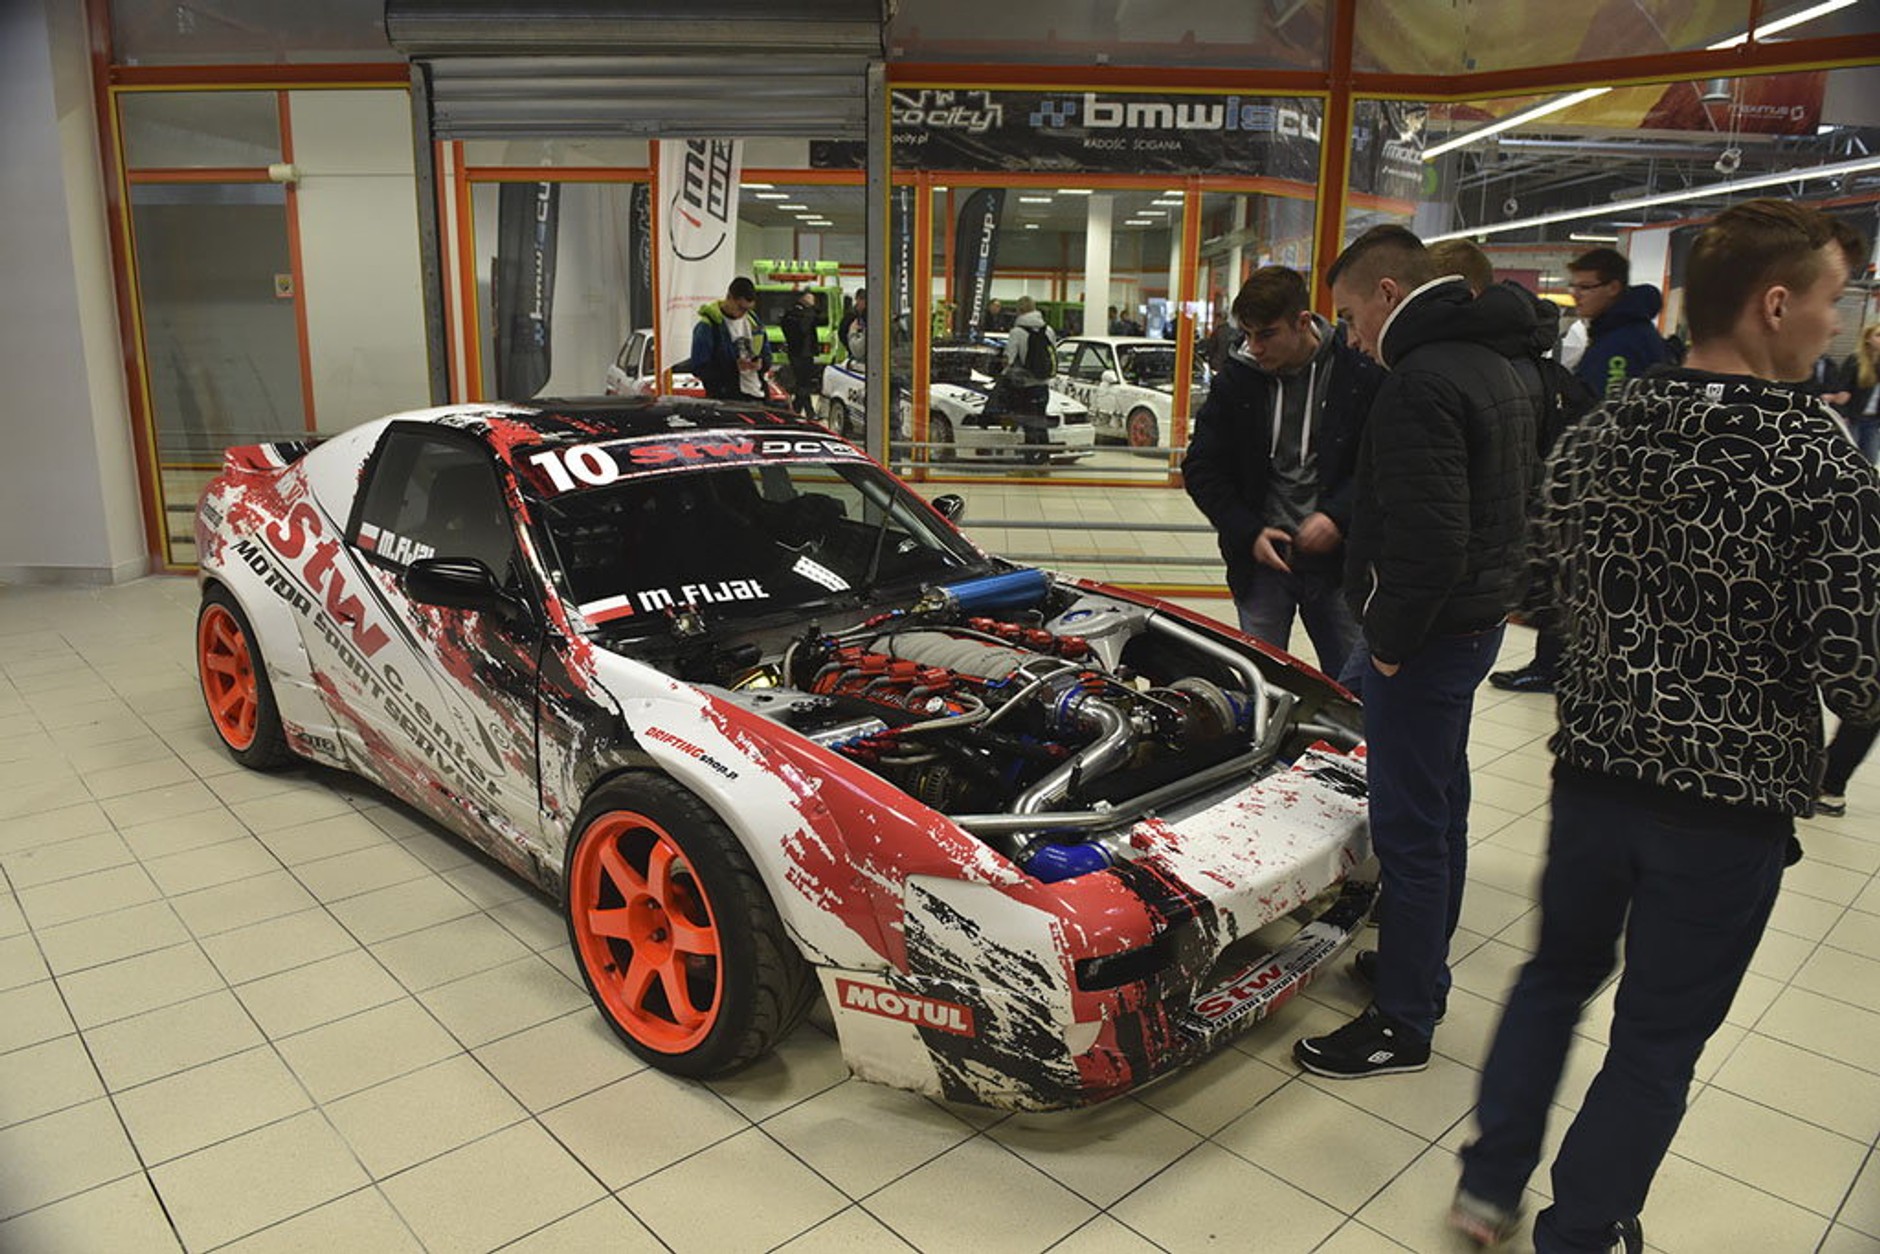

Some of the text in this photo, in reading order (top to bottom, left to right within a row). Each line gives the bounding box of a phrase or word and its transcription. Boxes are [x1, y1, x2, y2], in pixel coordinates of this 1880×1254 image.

[529, 445, 619, 492] 10
[230, 540, 312, 618] MOTOR
[265, 502, 391, 658] Stw
[846, 984, 967, 1031] MOTUL
